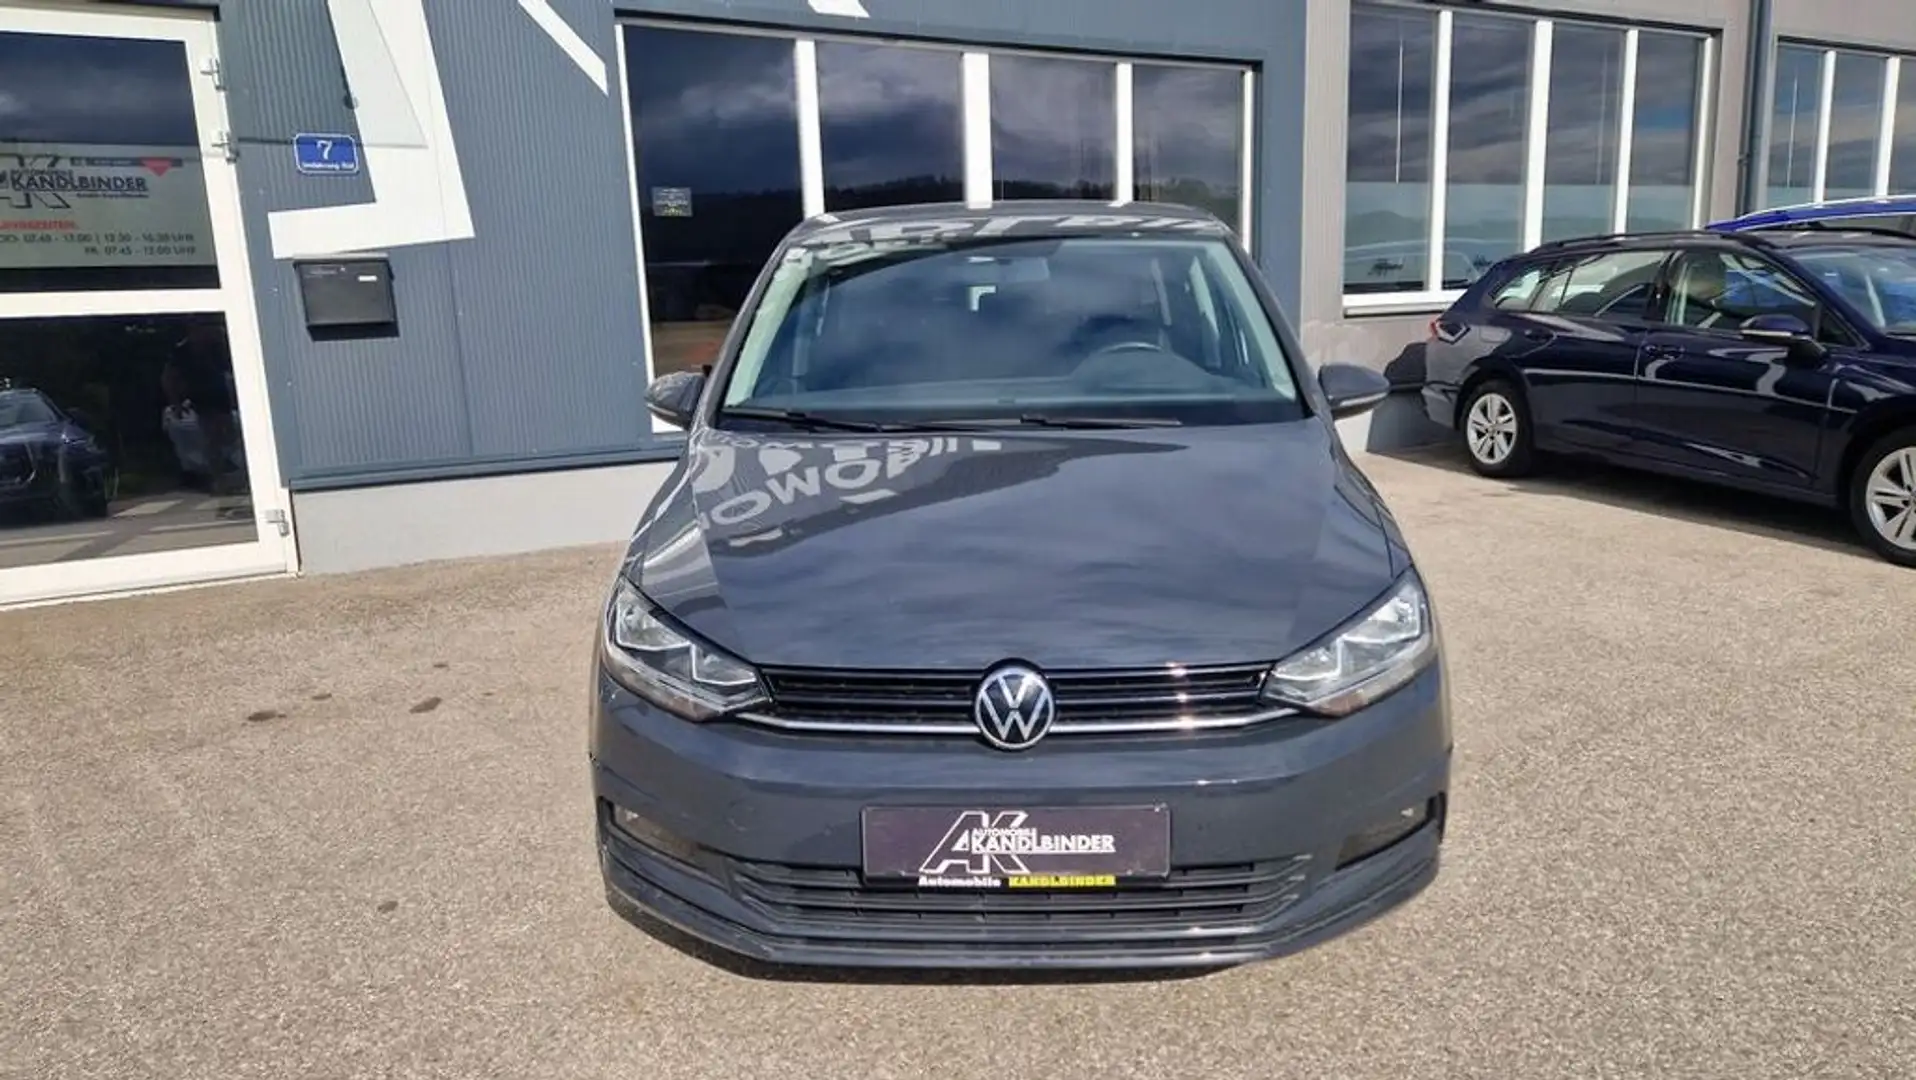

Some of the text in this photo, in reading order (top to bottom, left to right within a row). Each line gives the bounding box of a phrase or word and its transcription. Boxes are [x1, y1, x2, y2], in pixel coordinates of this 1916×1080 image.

[316, 140, 333, 160] 7
[11, 170, 149, 191] KANDLBINDER
[919, 811, 1031, 874] AK
[972, 829, 1115, 852] KANDLBINDER
[918, 874, 1116, 888] Automobile KANDLBINDER
